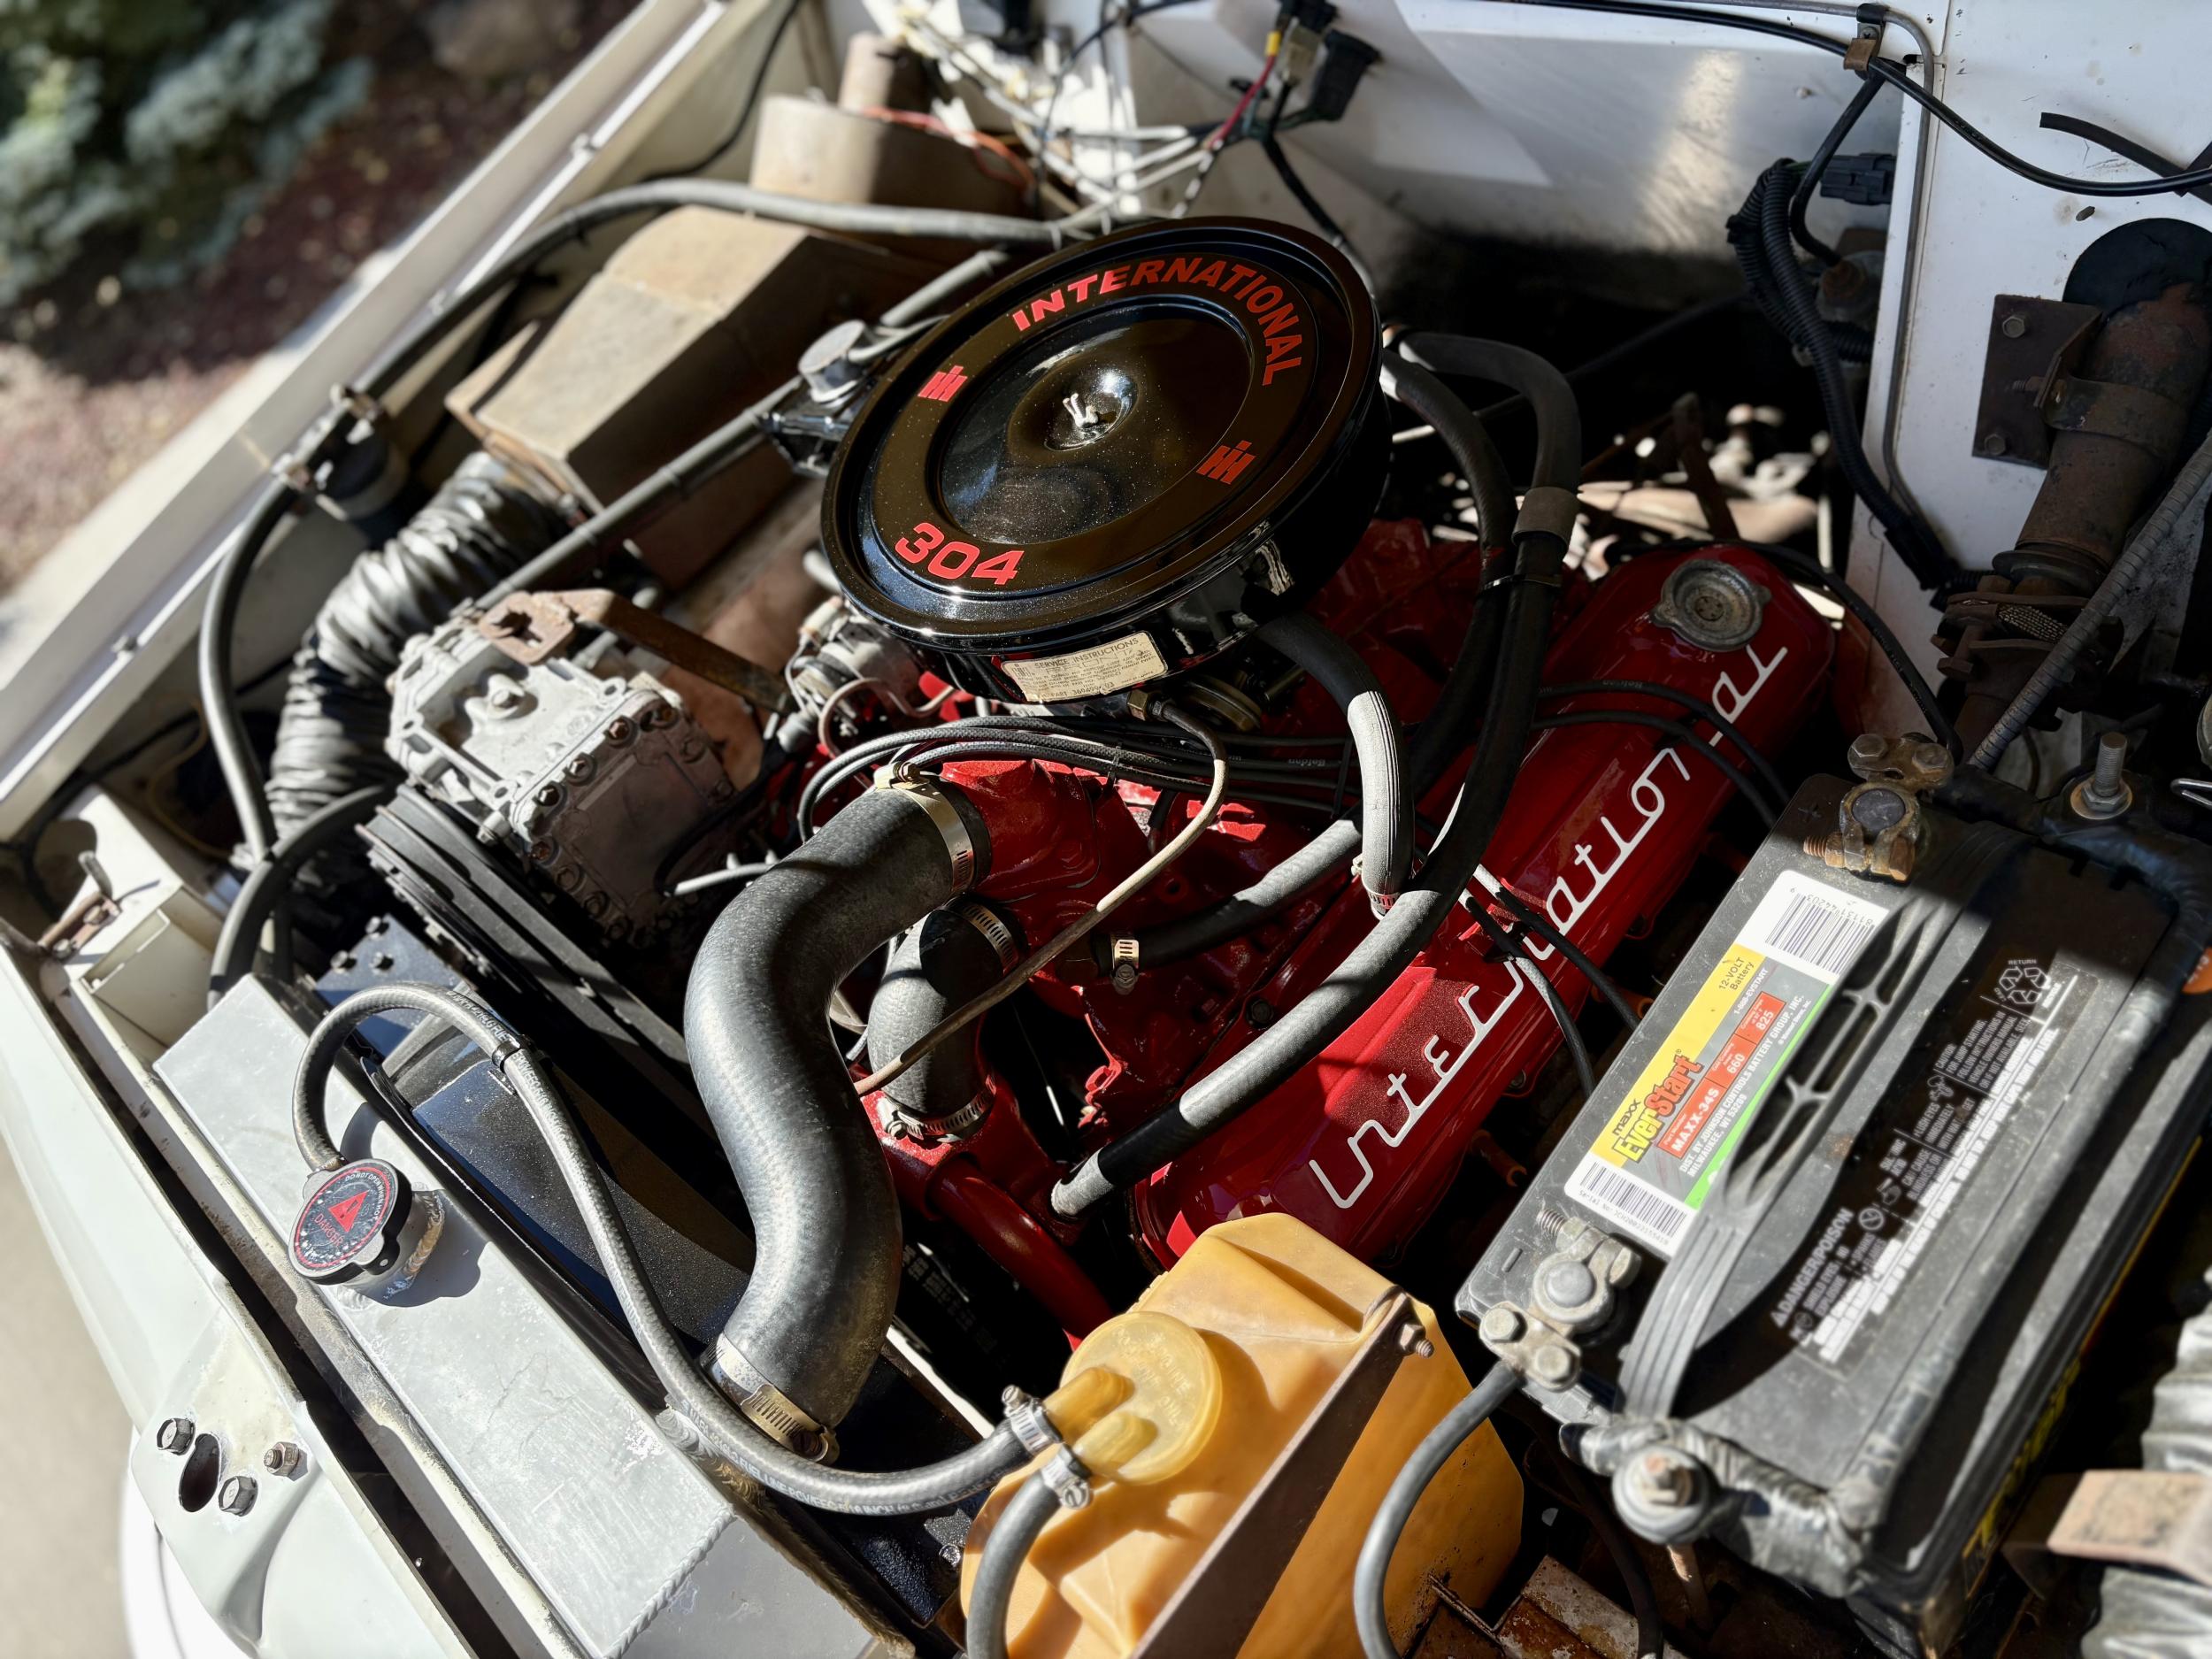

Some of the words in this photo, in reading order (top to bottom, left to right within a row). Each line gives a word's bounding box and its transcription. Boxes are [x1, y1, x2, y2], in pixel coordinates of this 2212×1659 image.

[1012, 257, 1302, 386] INTERNATIONAL
[895, 522, 1025, 586] 304
[1072, 638, 1139, 664] INSTRUCTIONS
[1718, 957, 1745, 990] 12-VOLT
[1730, 961, 1755, 990] Battery
[1755, 1009, 1775, 1030] 825
[1725, 1052, 1746, 1074] 660
[1955, 1055, 1977, 1079] FOLLOW
[1611, 1099, 1640, 1135] maxx
[1670, 1087, 1720, 1152] MAXX-34S
[1678, 1151, 1697, 1171] DIST.
[1692, 1141, 1704, 1153] BY
[1699, 1107, 1727, 1141] JOHNSON
[1722, 1070, 1752, 1108] CONTROLS
[1747, 1038, 1774, 1071] BATTERY
[1924, 1102, 1941, 1118] EYES
[1960, 1097, 1976, 1111] GET
[1923, 1103, 1955, 1144] IMMEDIATELY
[1686, 1127, 1724, 1177] MILWAUKEE,
[1719, 1116, 1732, 1128] WI
[367, 1173, 380, 1185] OPEN
[314, 1212, 344, 1246] DANGER
[1777, 1207, 1855, 1313] DANGER/POISON
